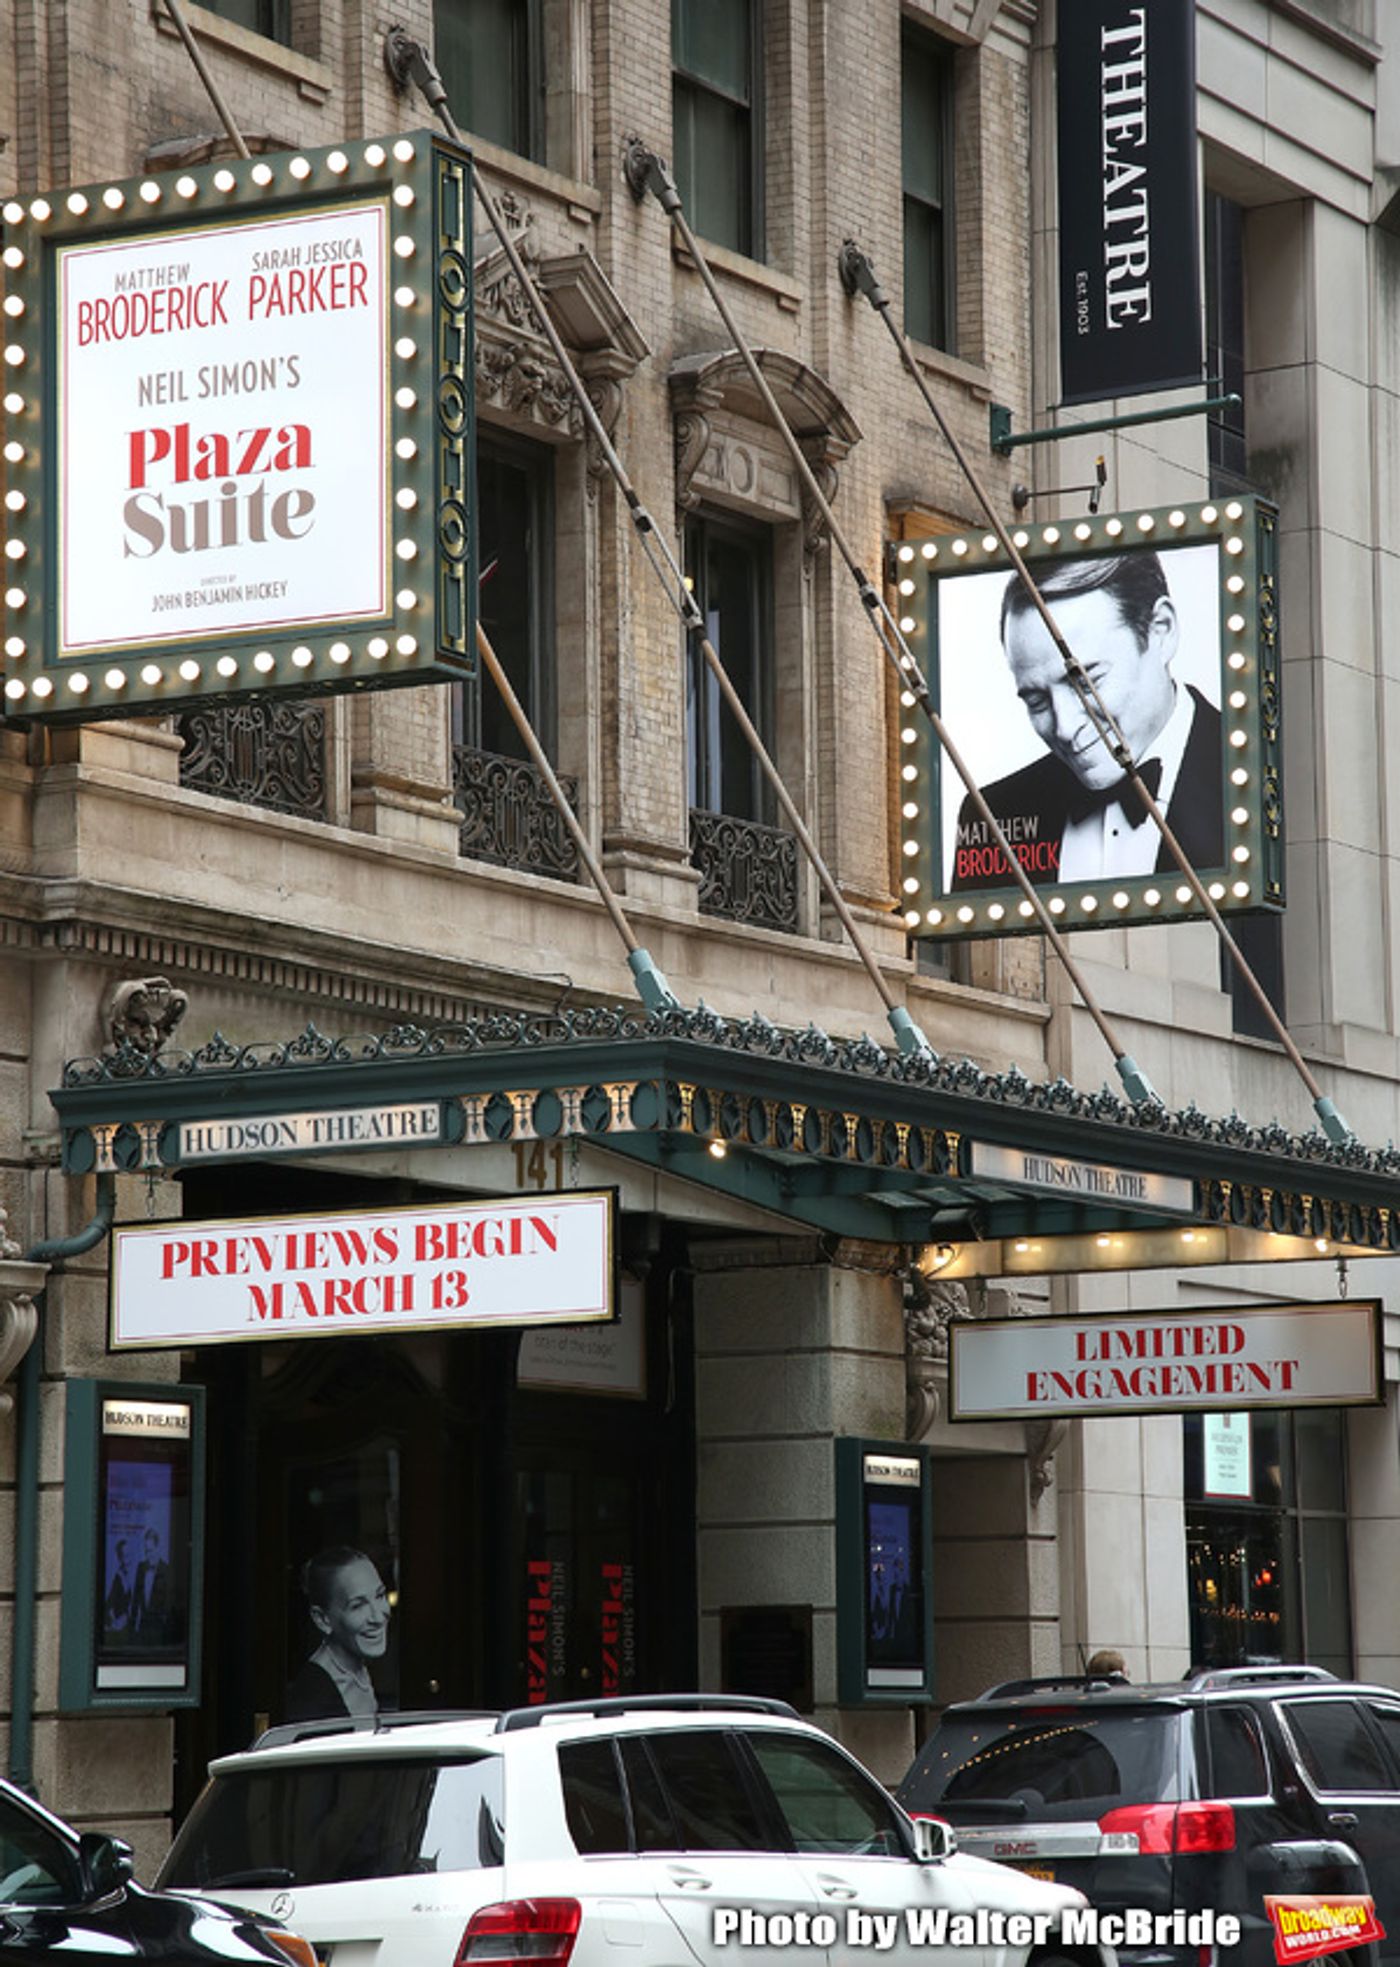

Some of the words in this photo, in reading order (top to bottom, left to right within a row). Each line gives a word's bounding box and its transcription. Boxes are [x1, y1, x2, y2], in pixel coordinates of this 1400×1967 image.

[1101, 8, 1152, 329] THEATRE
[114, 262, 191, 293] MATTHEW
[251, 247, 301, 273] SARAH
[303, 238, 364, 266] JESSICA
[78, 280, 229, 347] BRODERICK
[248, 261, 369, 321] PARKER
[138, 369, 189, 407] NEIL
[198, 354, 301, 399] SIMON'S
[123, 421, 317, 490] Plaza
[122, 479, 317, 560] Suite
[151, 593, 182, 613] JOHN
[184, 585, 243, 609] BENJAMIN
[245, 579, 288, 601] HICKEY
[184, 1117, 298, 1154] HUDSON
[306, 1107, 439, 1143] THEATRE
[511, 1141, 564, 1190] 141
[1023, 1156, 1082, 1189] HUDSON
[1085, 1167, 1148, 1199] THEATRE
[158, 1226, 404, 1280] PREVIEWS
[413, 1213, 561, 1262] BEGIN
[247, 1274, 415, 1323] MARCH
[429, 1269, 470, 1312] 13
[1075, 1323, 1246, 1362] LIMITED
[1026, 1359, 1299, 1403] ENGAGEMENT
[105, 1410, 144, 1426] HUDSON
[146, 1413, 188, 1429] THEATRE
[552, 1561, 566, 1599] NEIL
[623, 1564, 635, 1602] NEIL
[993, 1842, 1039, 1856] GMC
